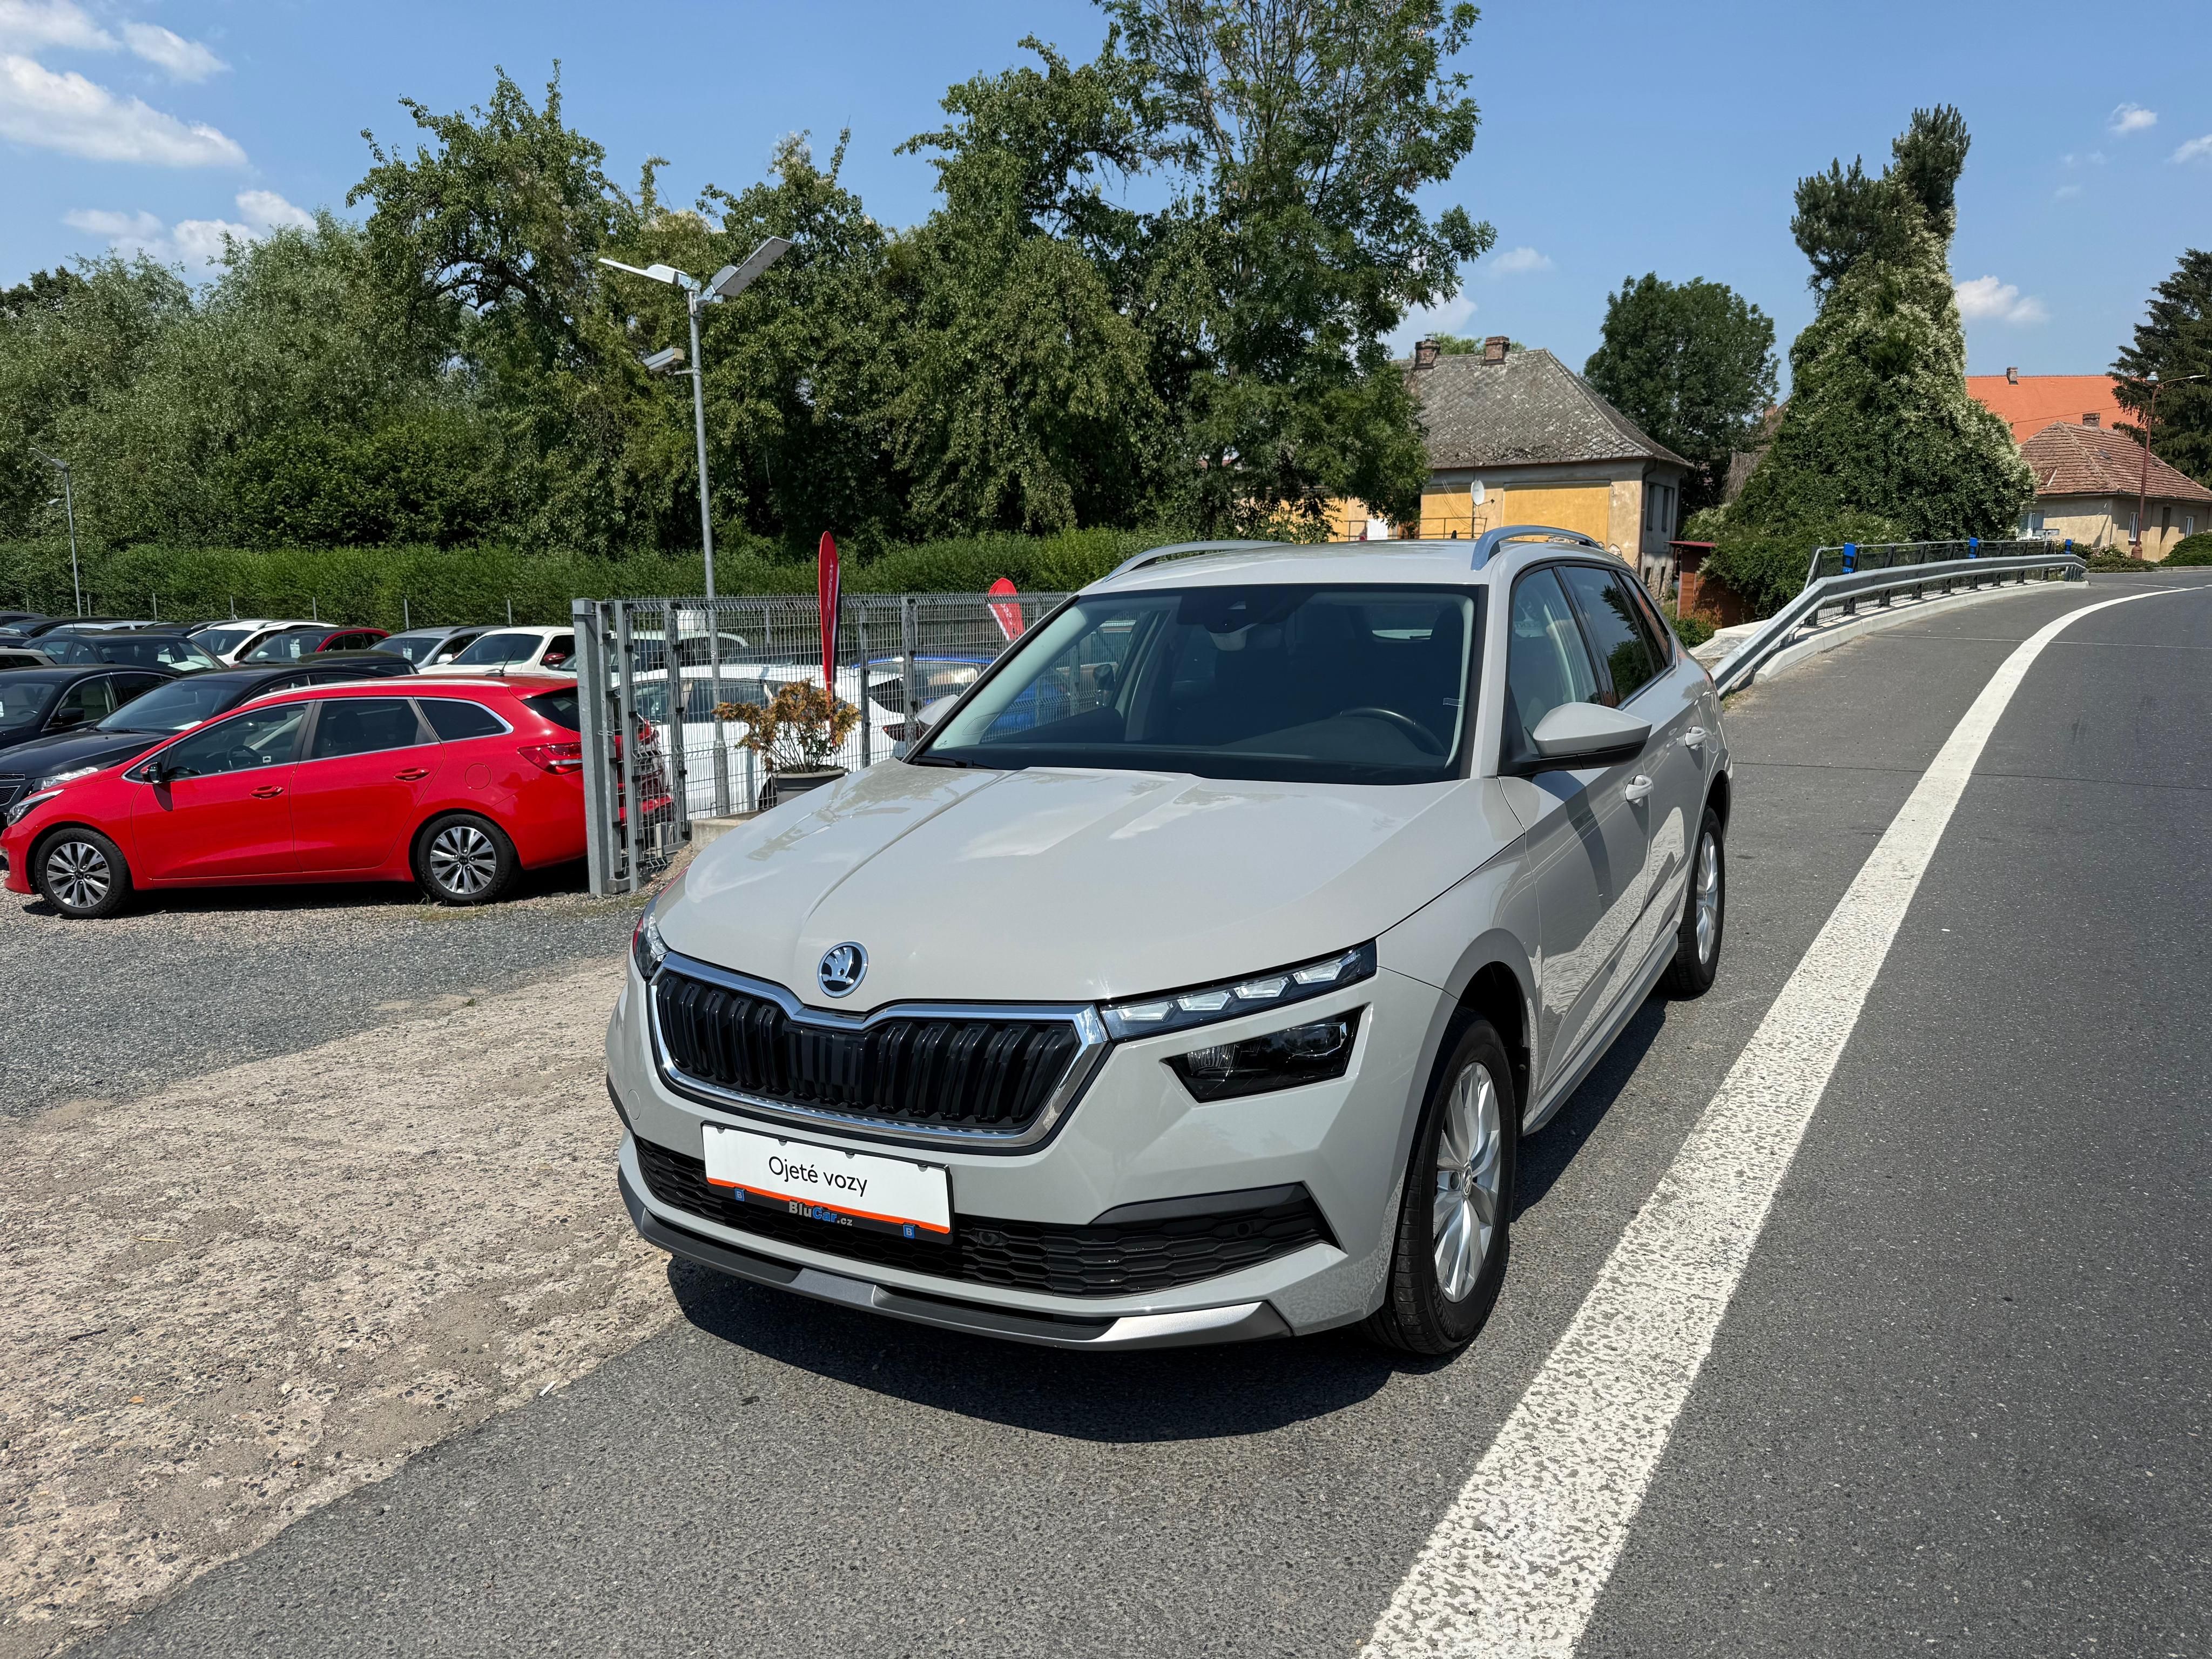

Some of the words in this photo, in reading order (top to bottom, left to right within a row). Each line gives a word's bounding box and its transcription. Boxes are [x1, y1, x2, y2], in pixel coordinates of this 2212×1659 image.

[768, 1156, 818, 1183] Ojeté
[823, 1172, 868, 1198] vozy
[788, 1201, 853, 1226] BluCar.cz
[906, 1227, 913, 1236] B
